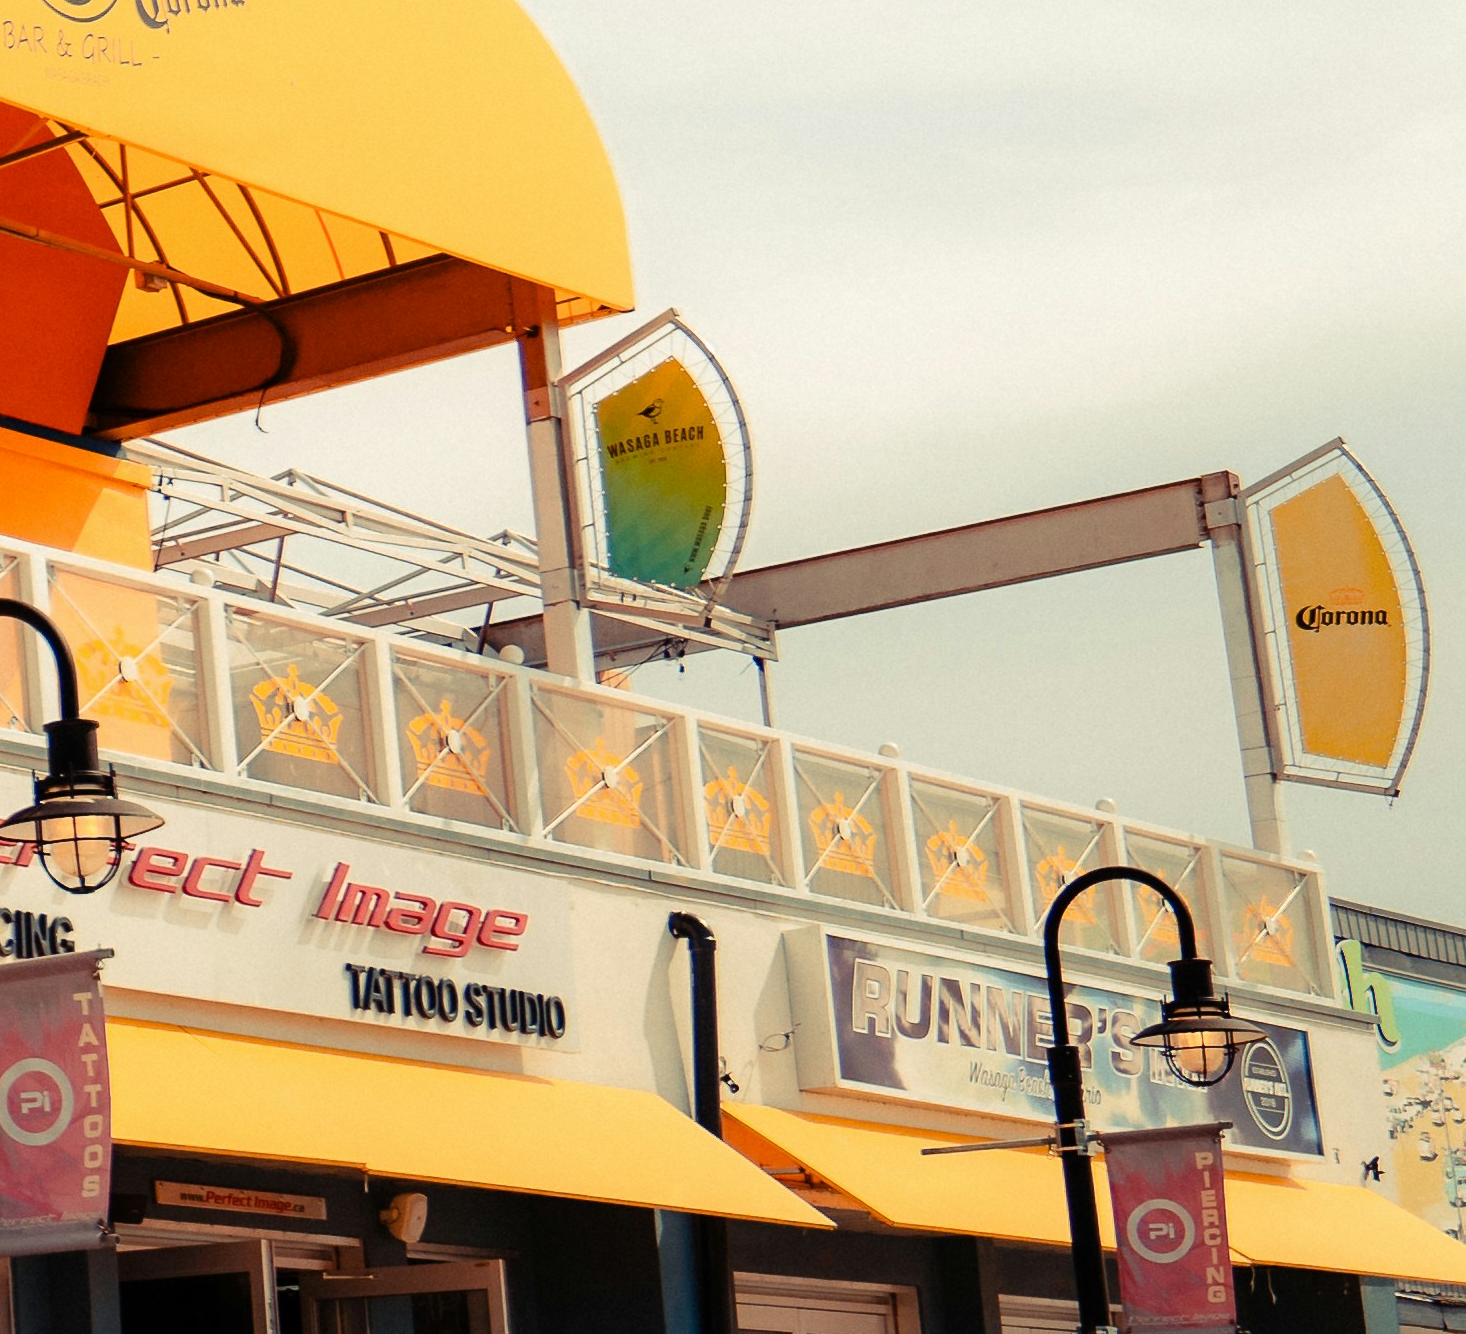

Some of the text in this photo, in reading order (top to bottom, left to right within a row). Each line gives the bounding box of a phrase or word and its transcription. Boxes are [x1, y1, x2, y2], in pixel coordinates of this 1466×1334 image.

[3, 20, 47, 54] BAR
[82, 33, 142, 67] GRILL
[607, 425, 704, 459] WASAGA BEACH
[314, 861, 528, 959] Image
[345, 963, 566, 1040] TATTOO STUDIO
[73, 992, 105, 1198] TATTOOS
[1195, 1151, 1227, 1304] PIERCING
